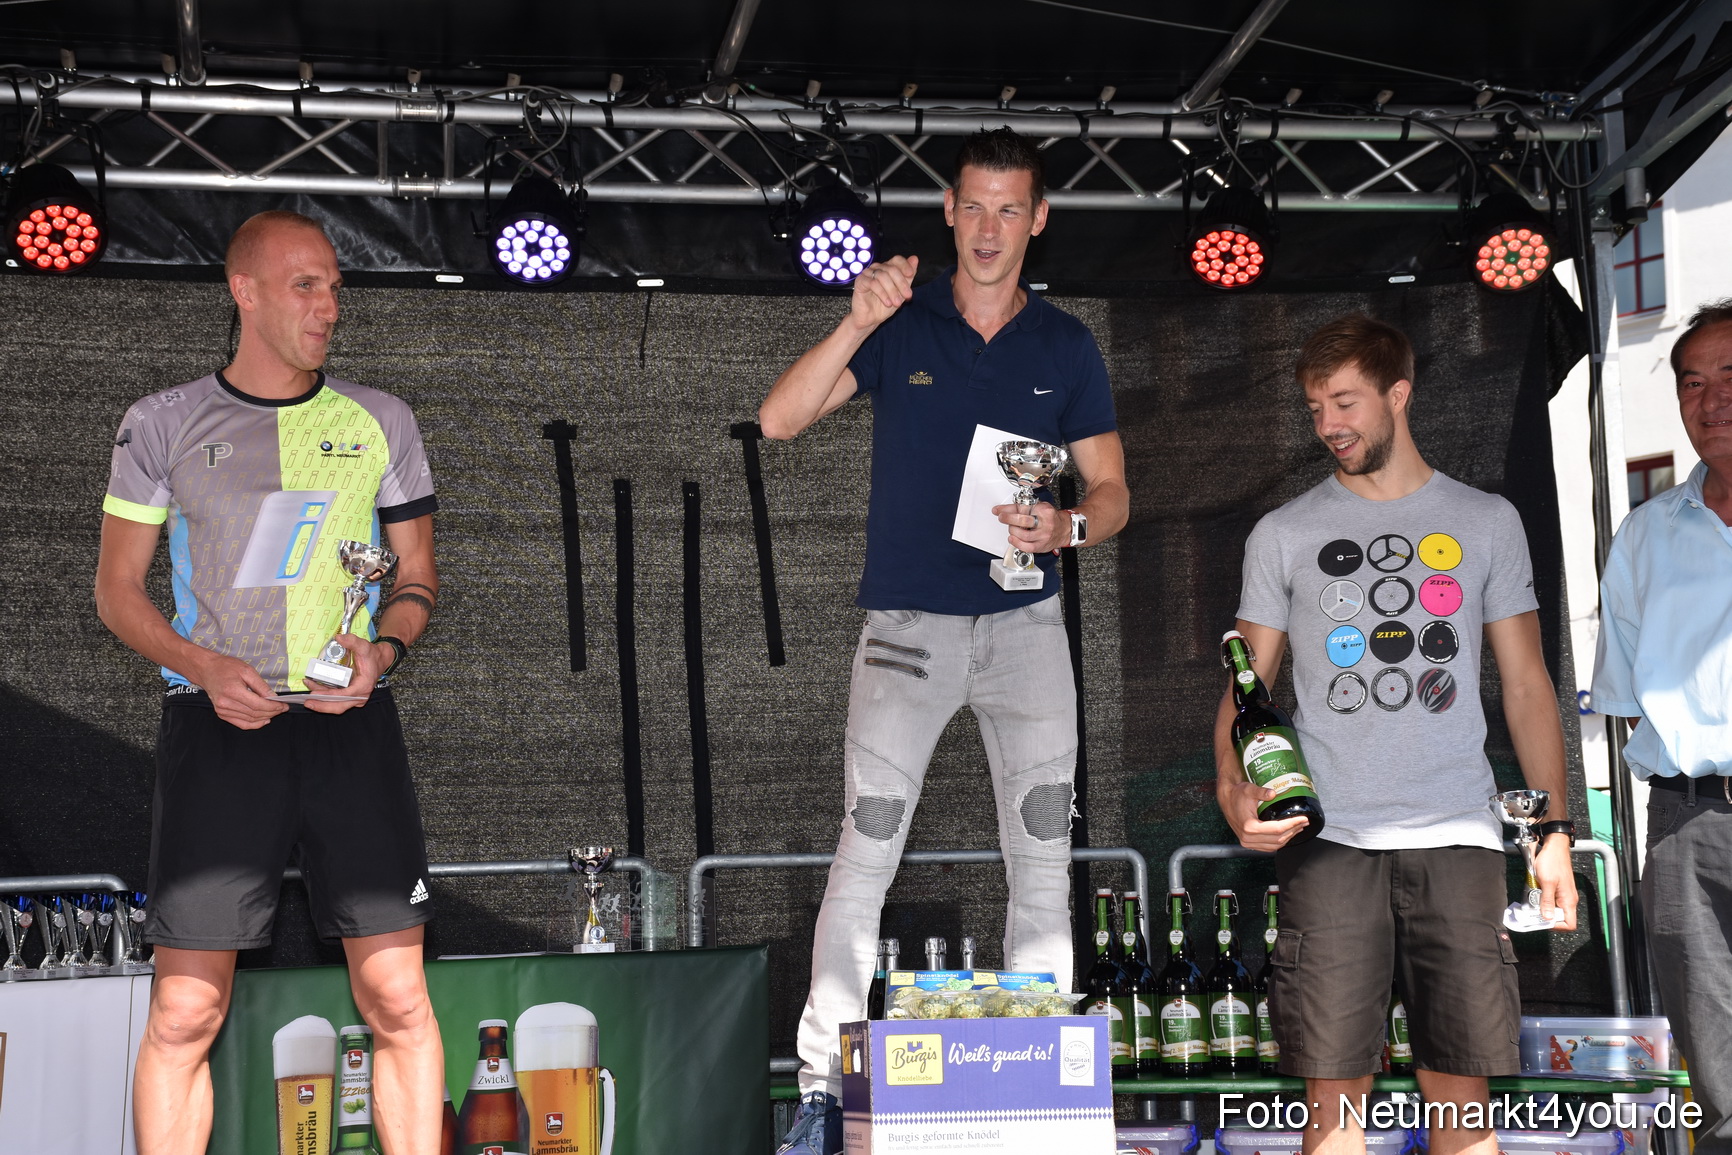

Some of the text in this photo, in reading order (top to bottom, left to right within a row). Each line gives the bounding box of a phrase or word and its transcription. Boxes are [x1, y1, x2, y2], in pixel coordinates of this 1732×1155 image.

[1331, 634, 1359, 644] ZIPP
[1376, 631, 1407, 639] ZIPP
[1249, 744, 1281, 758] Lammsbräu
[410, 892, 429, 904] adidas
[891, 1047, 937, 1074] Burgis
[992, 1044, 1033, 1073] guad
[1033, 1043, 1054, 1061] is!
[477, 1075, 510, 1085] Zwickl
[538, 1138, 573, 1146] Neumarkter
[888, 1129, 1001, 1144] Burgis geformte Knödel
[532, 1145, 579, 1155] Lammsbräu
